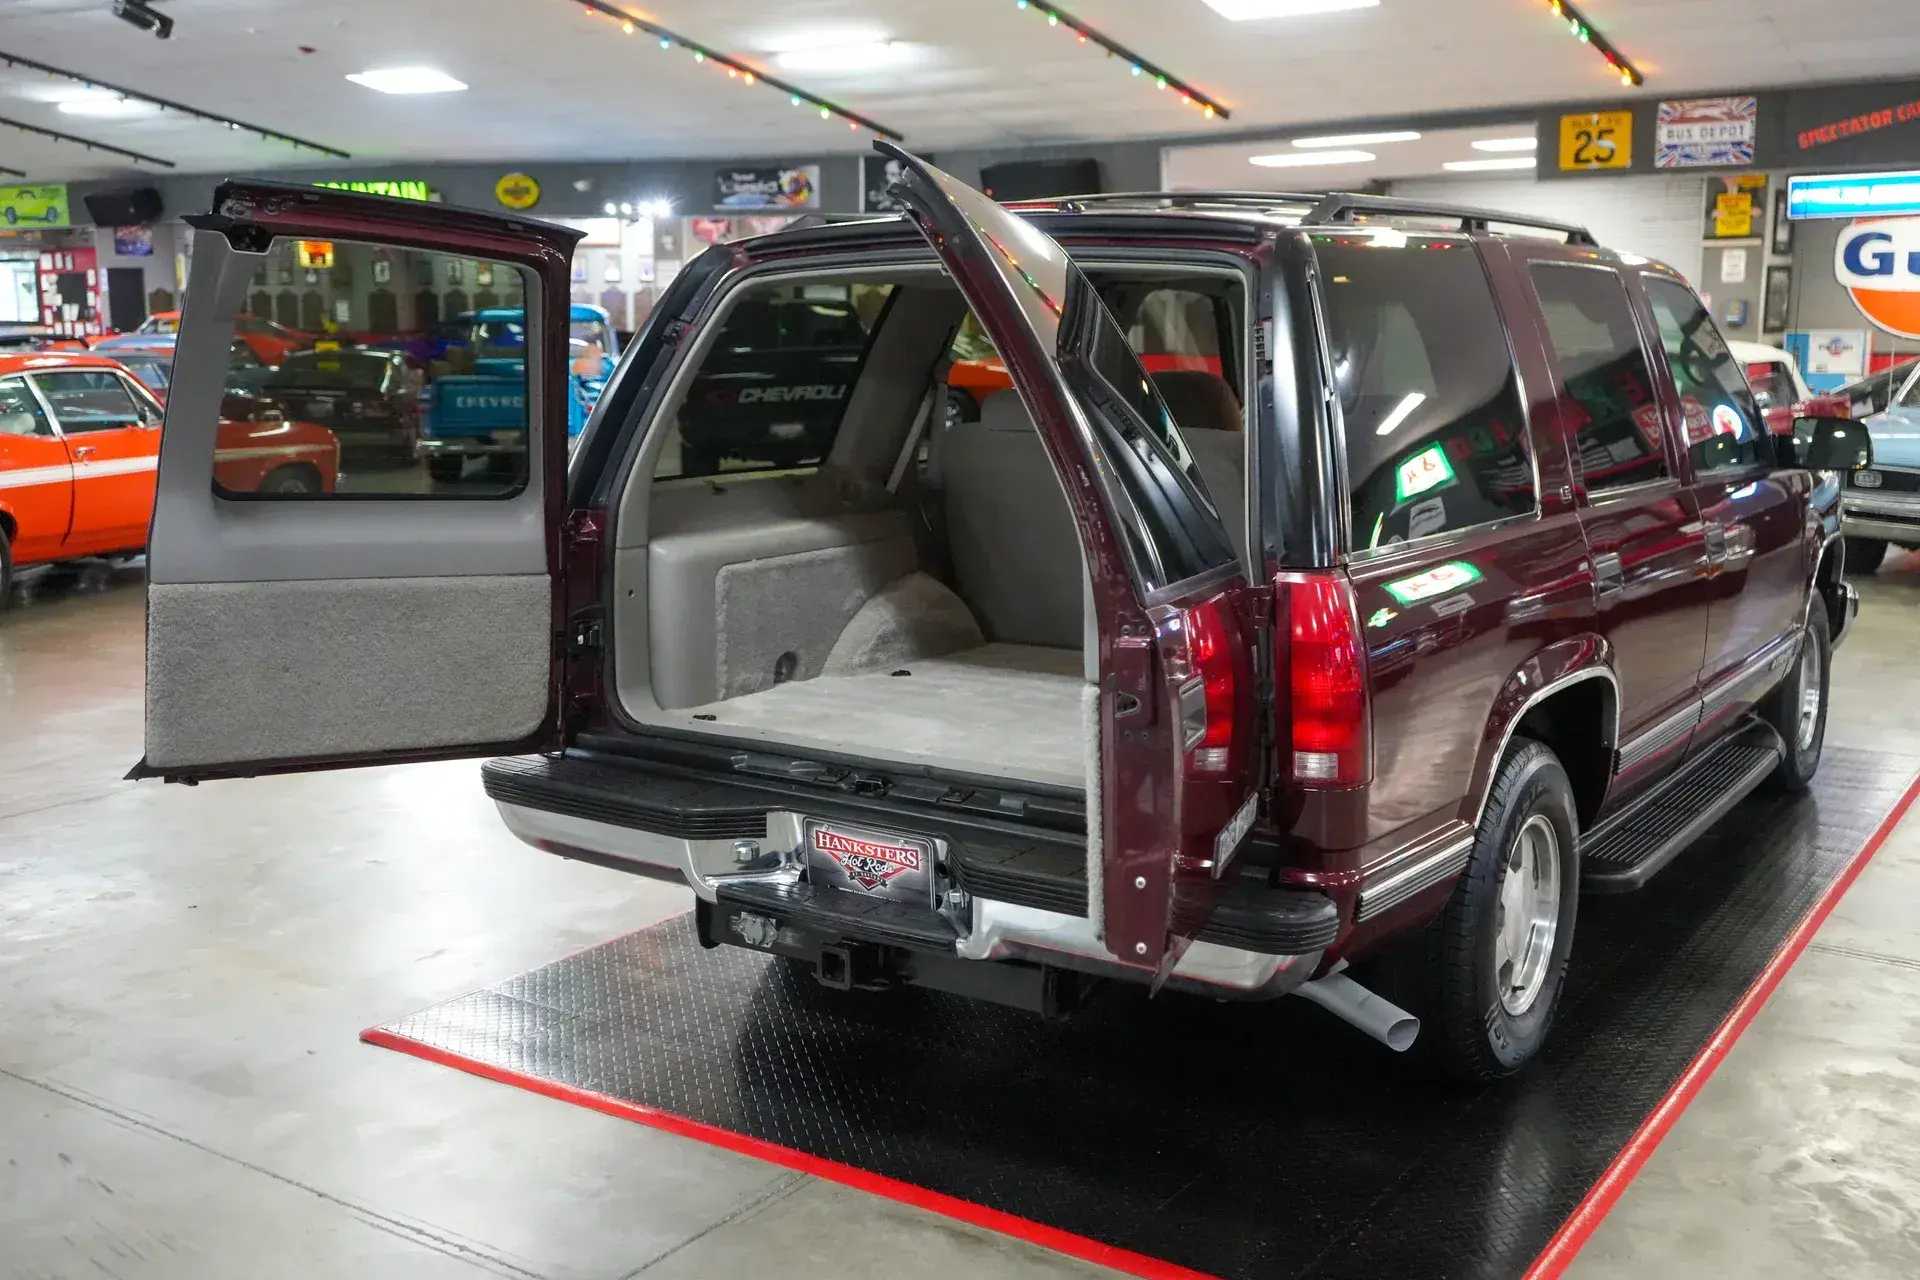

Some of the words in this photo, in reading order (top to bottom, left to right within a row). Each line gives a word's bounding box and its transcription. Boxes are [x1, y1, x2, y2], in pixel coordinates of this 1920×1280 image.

[1573, 129, 1616, 164] 25
[1667, 127, 1693, 140] BUS
[1700, 124, 1745, 138] DEPOT
[1843, 231, 1920, 277] G
[817, 831, 919, 867] HANKSTERS
[841, 852, 864, 868] Hot
[865, 856, 895, 875] Rods
